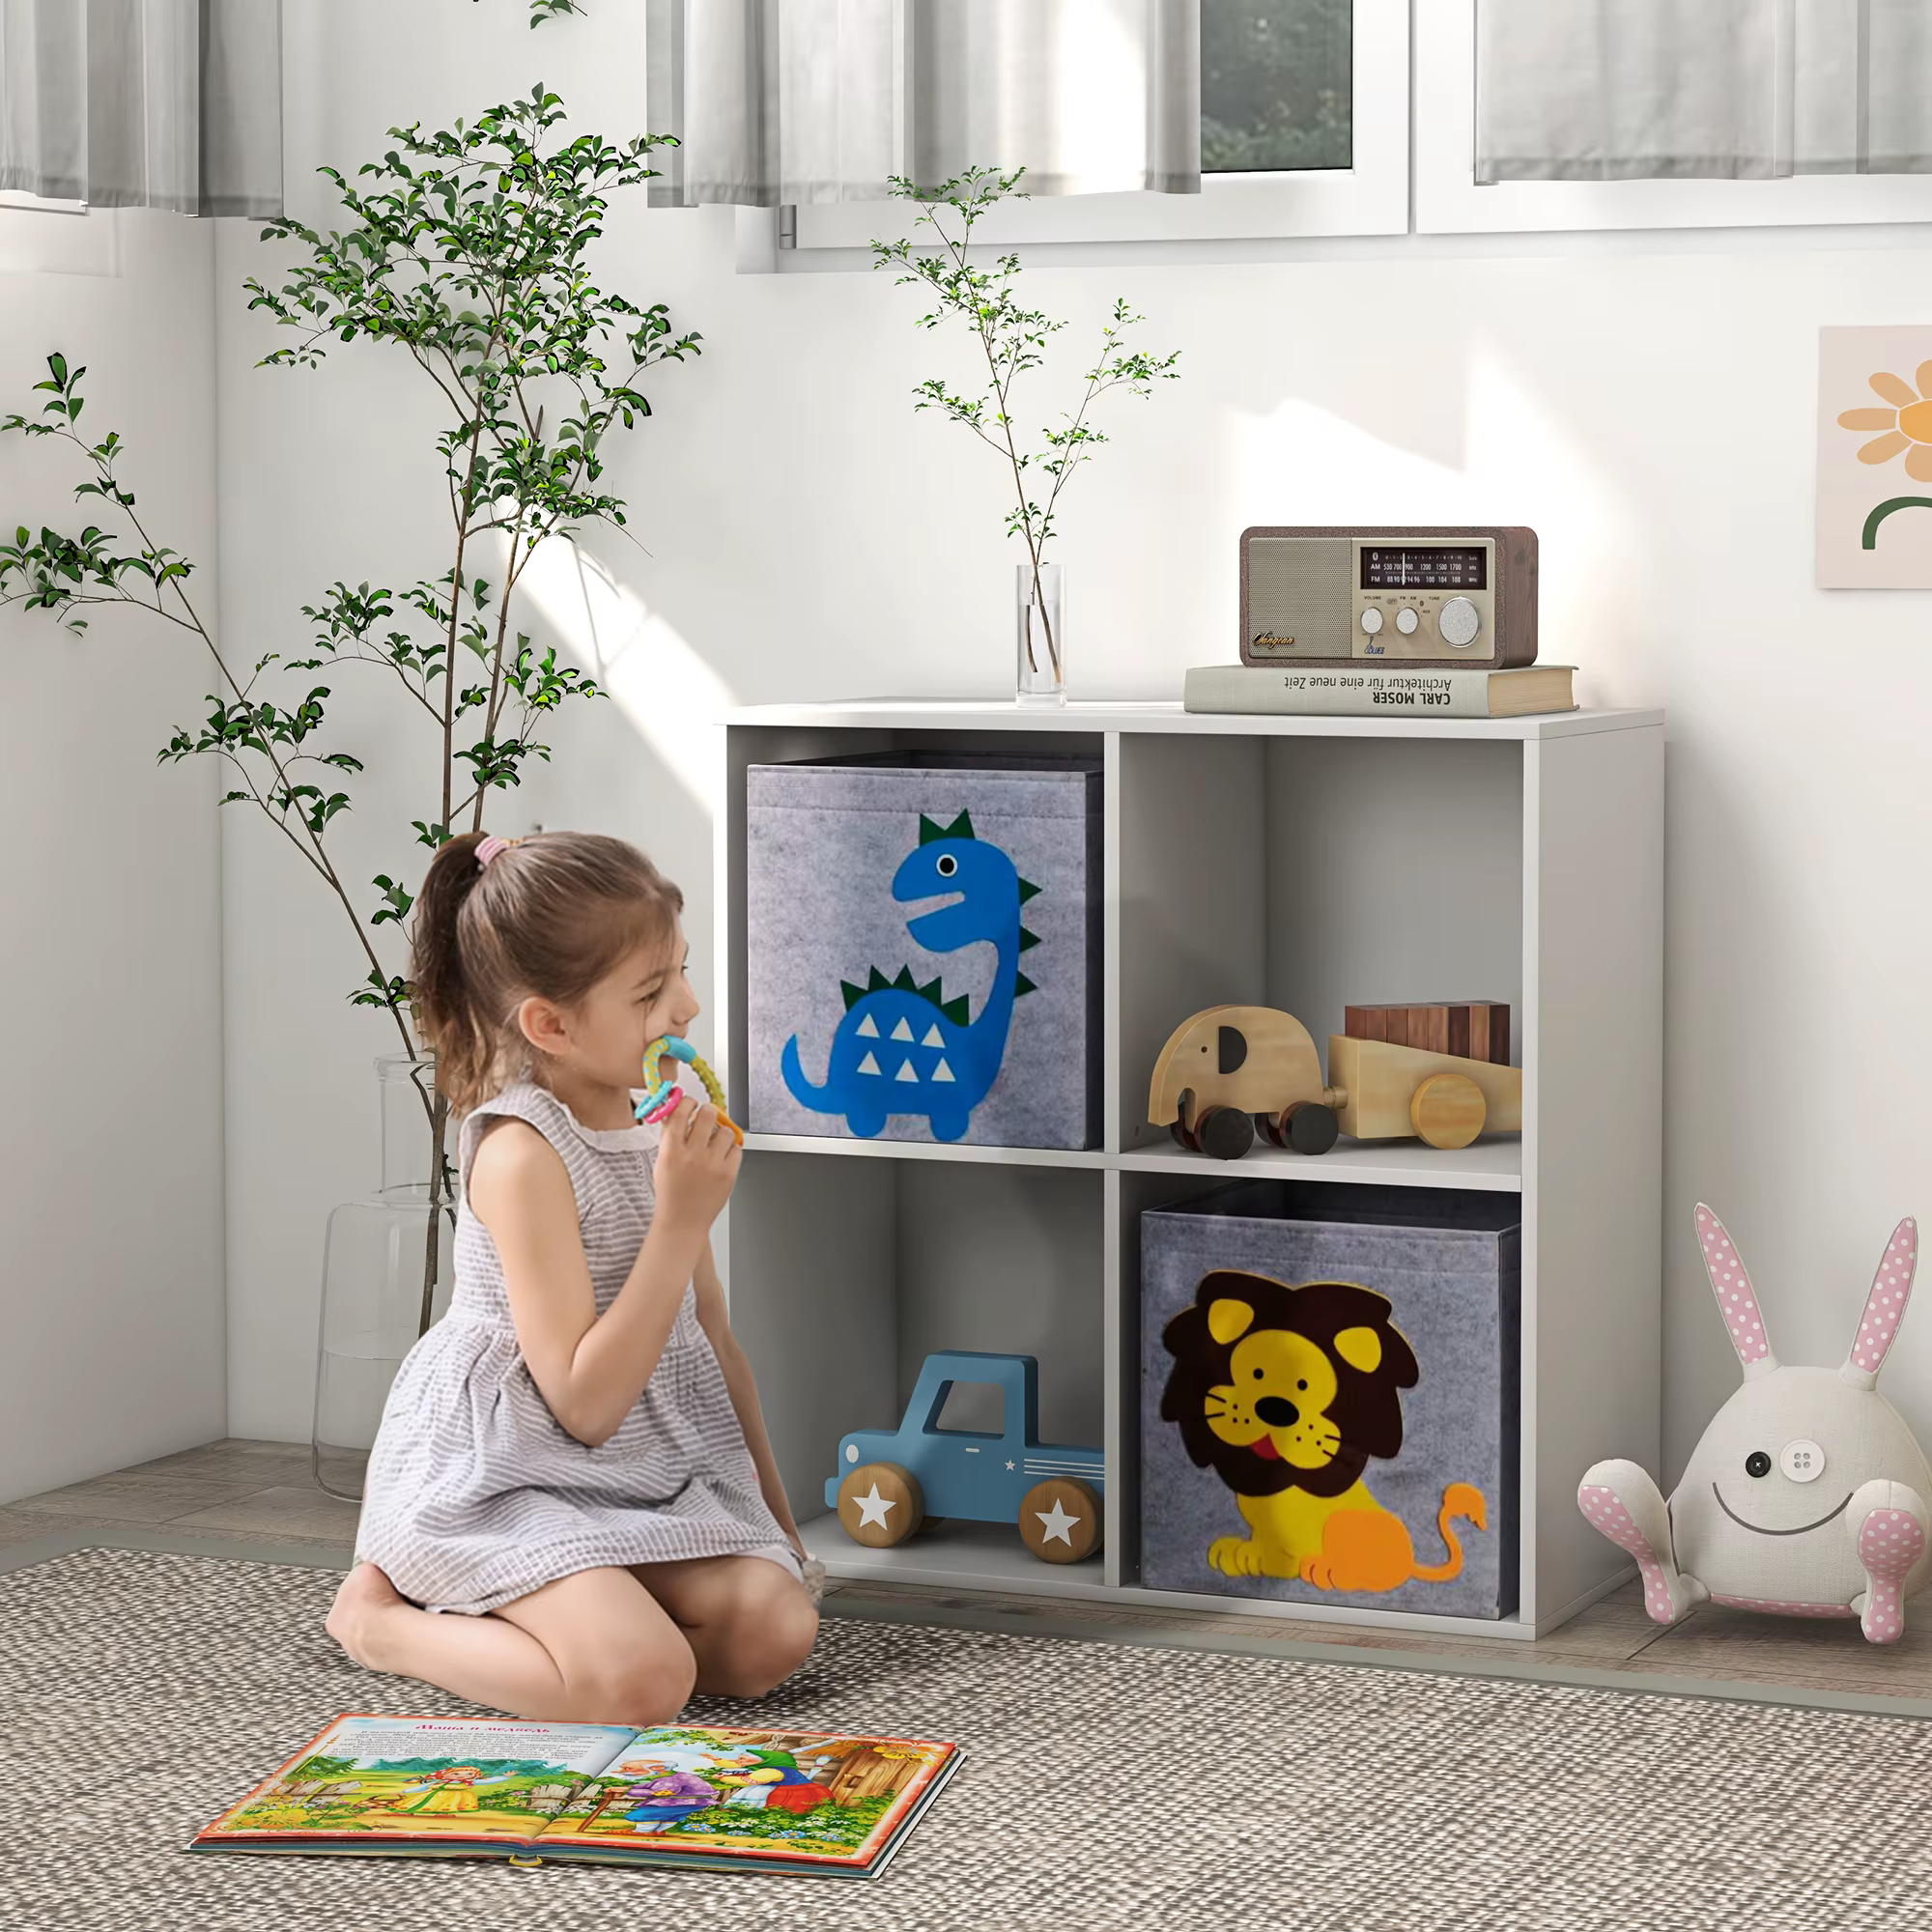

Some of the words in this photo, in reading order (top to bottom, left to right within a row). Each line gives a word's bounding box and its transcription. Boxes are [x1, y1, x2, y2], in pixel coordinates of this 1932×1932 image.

[1284, 677, 1307, 690] Zeit
[1309, 677, 1336, 687] neue
[1340, 677, 1364, 690] eine
[1367, 677, 1384, 691] für
[1388, 678, 1452, 692] Architektur
[1373, 692, 1415, 704] MOSER
[1419, 692, 1451, 705] CARL
